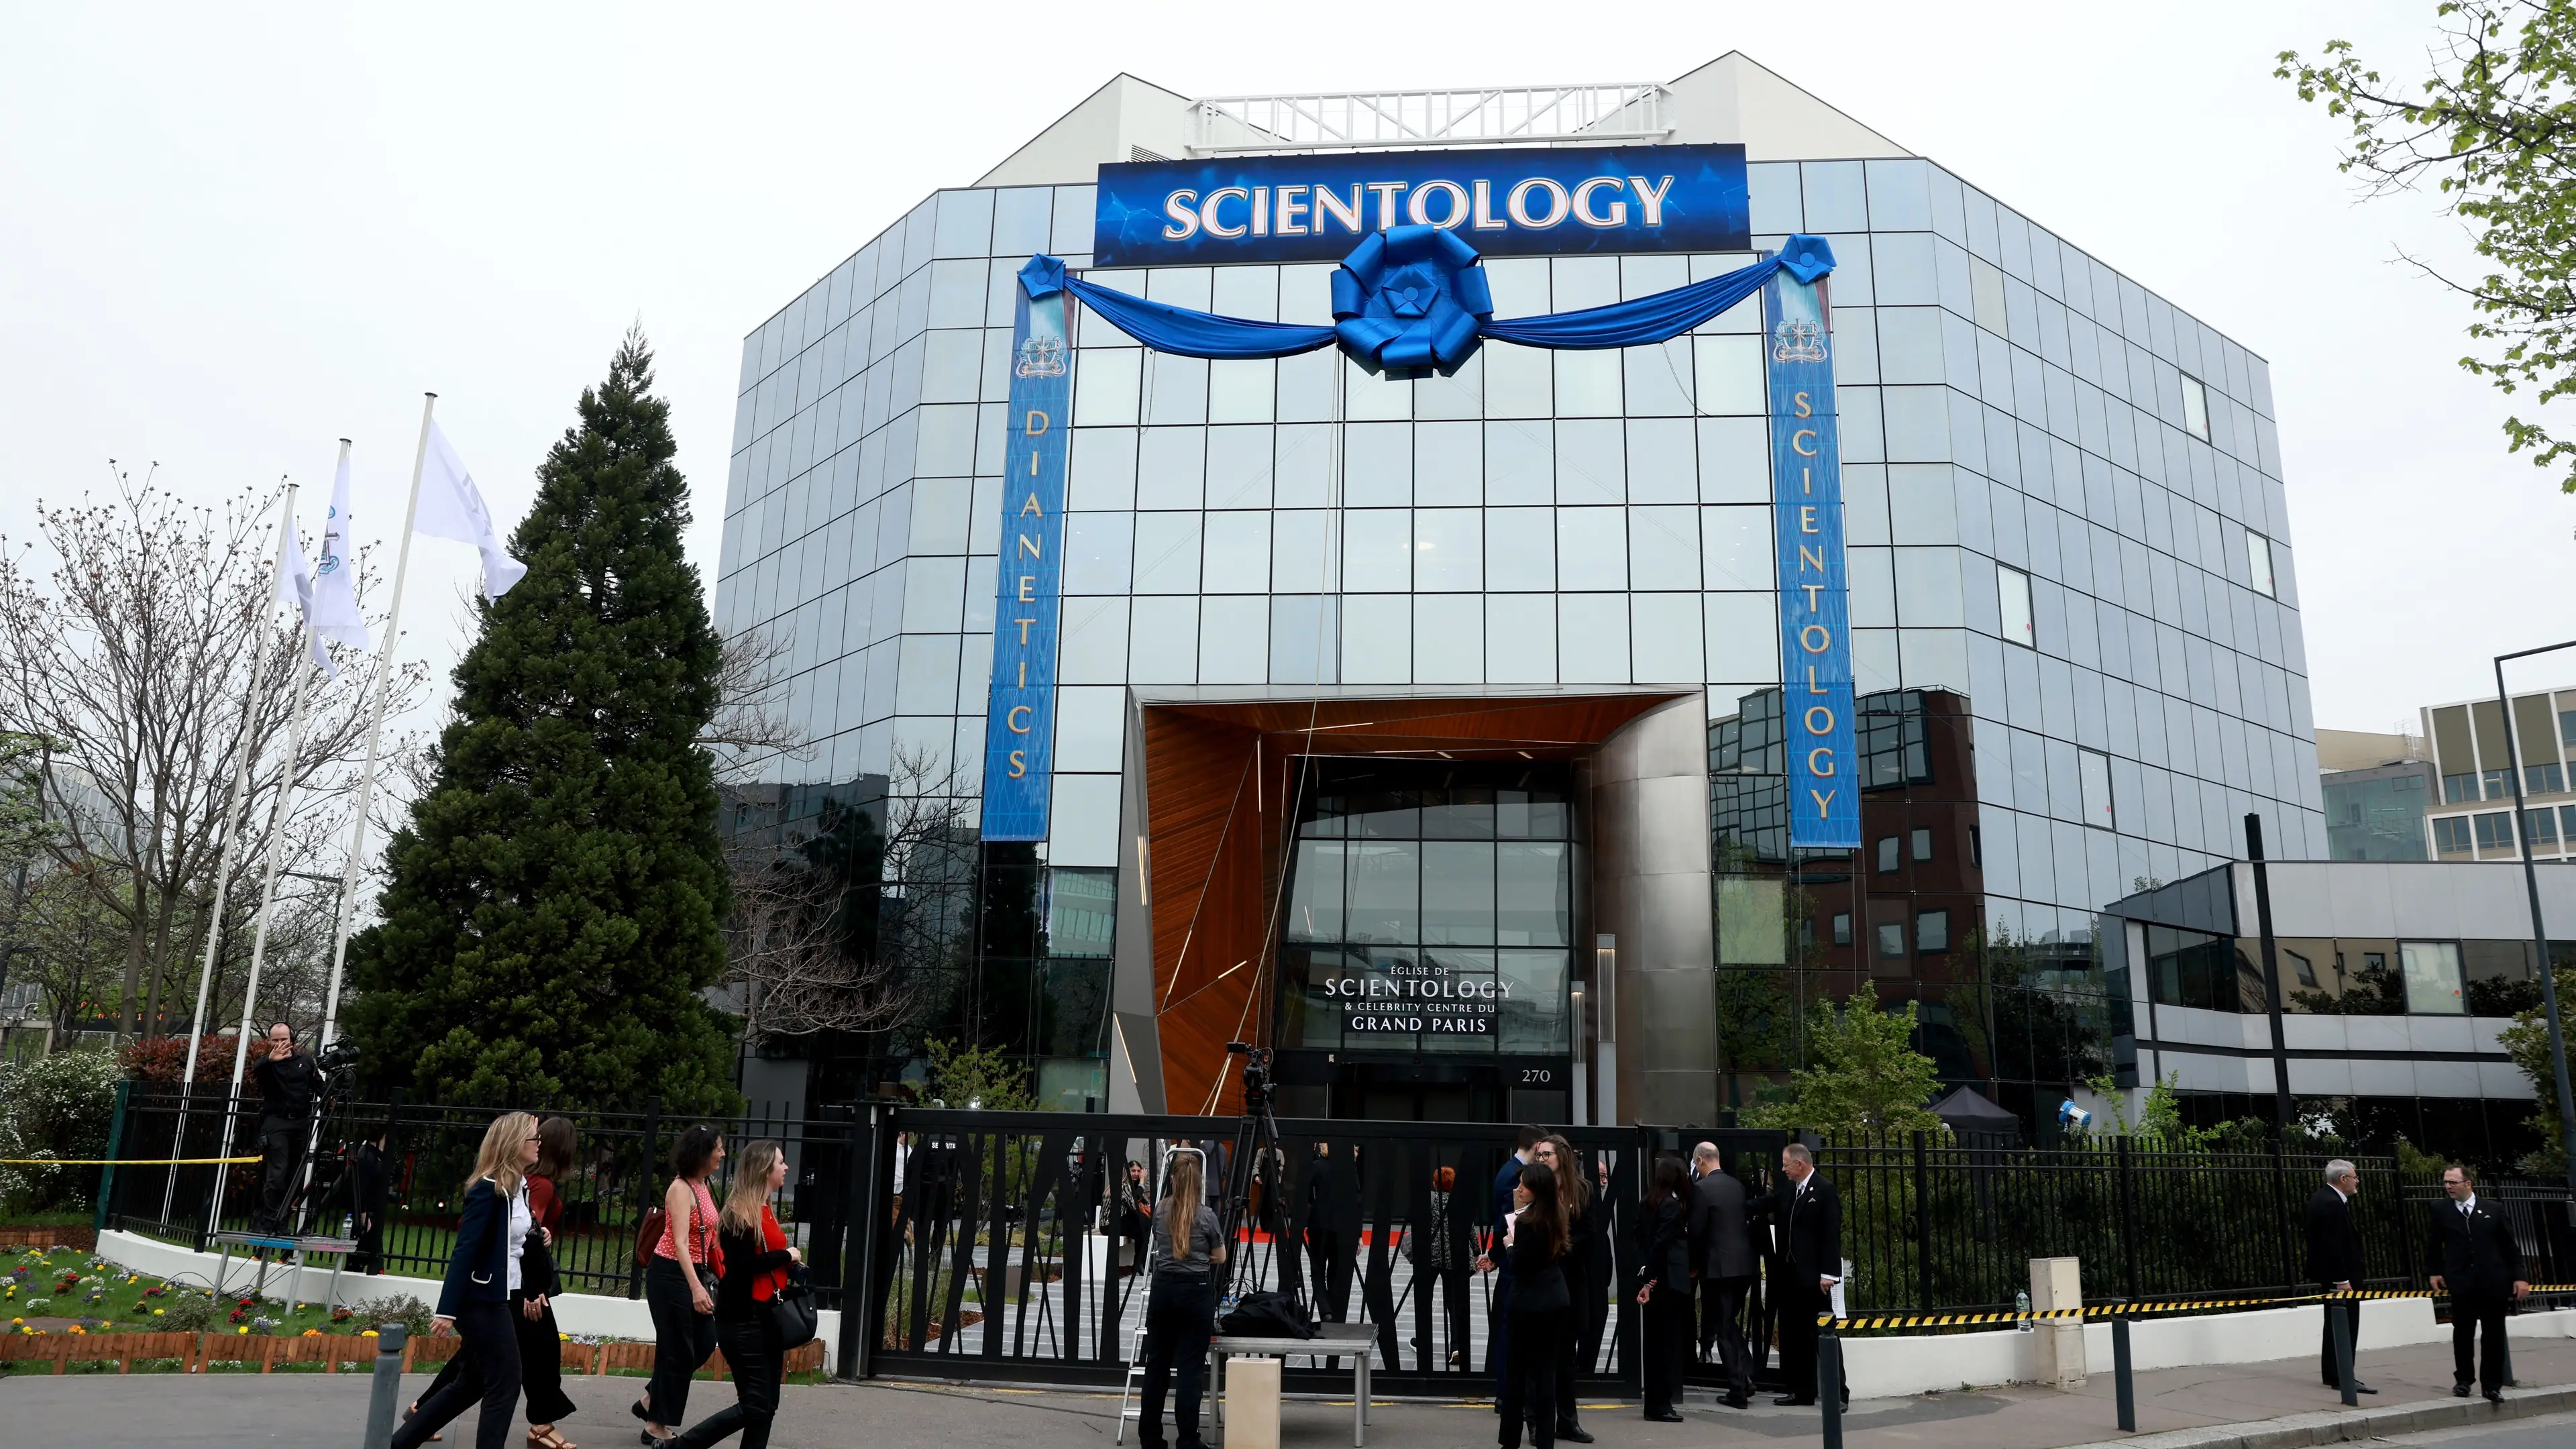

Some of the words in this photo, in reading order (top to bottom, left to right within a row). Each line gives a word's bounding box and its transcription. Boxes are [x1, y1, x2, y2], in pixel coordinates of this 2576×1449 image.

[1163, 174, 1674, 239] SCIENTOLOGY
[1007, 410, 1050, 780] DIANETICS
[1792, 392, 1835, 819] SCIENTOLOGY
[1390, 964, 1430, 976] ÉGLISE
[1434, 967, 1450, 976] DE
[1324, 977, 1515, 999] SCIENTOLOGY
[1344, 1002, 1353, 1012] &
[1357, 1002, 1421, 1012] CELEBRITY
[1426, 1002, 1472, 1013] CENTRE
[1478, 1004, 1495, 1013] DU
[1351, 1016, 1423, 1032] GRAND
[1432, 1017, 1487, 1032] PARIS
[1521, 1069, 1551, 1083] 270
